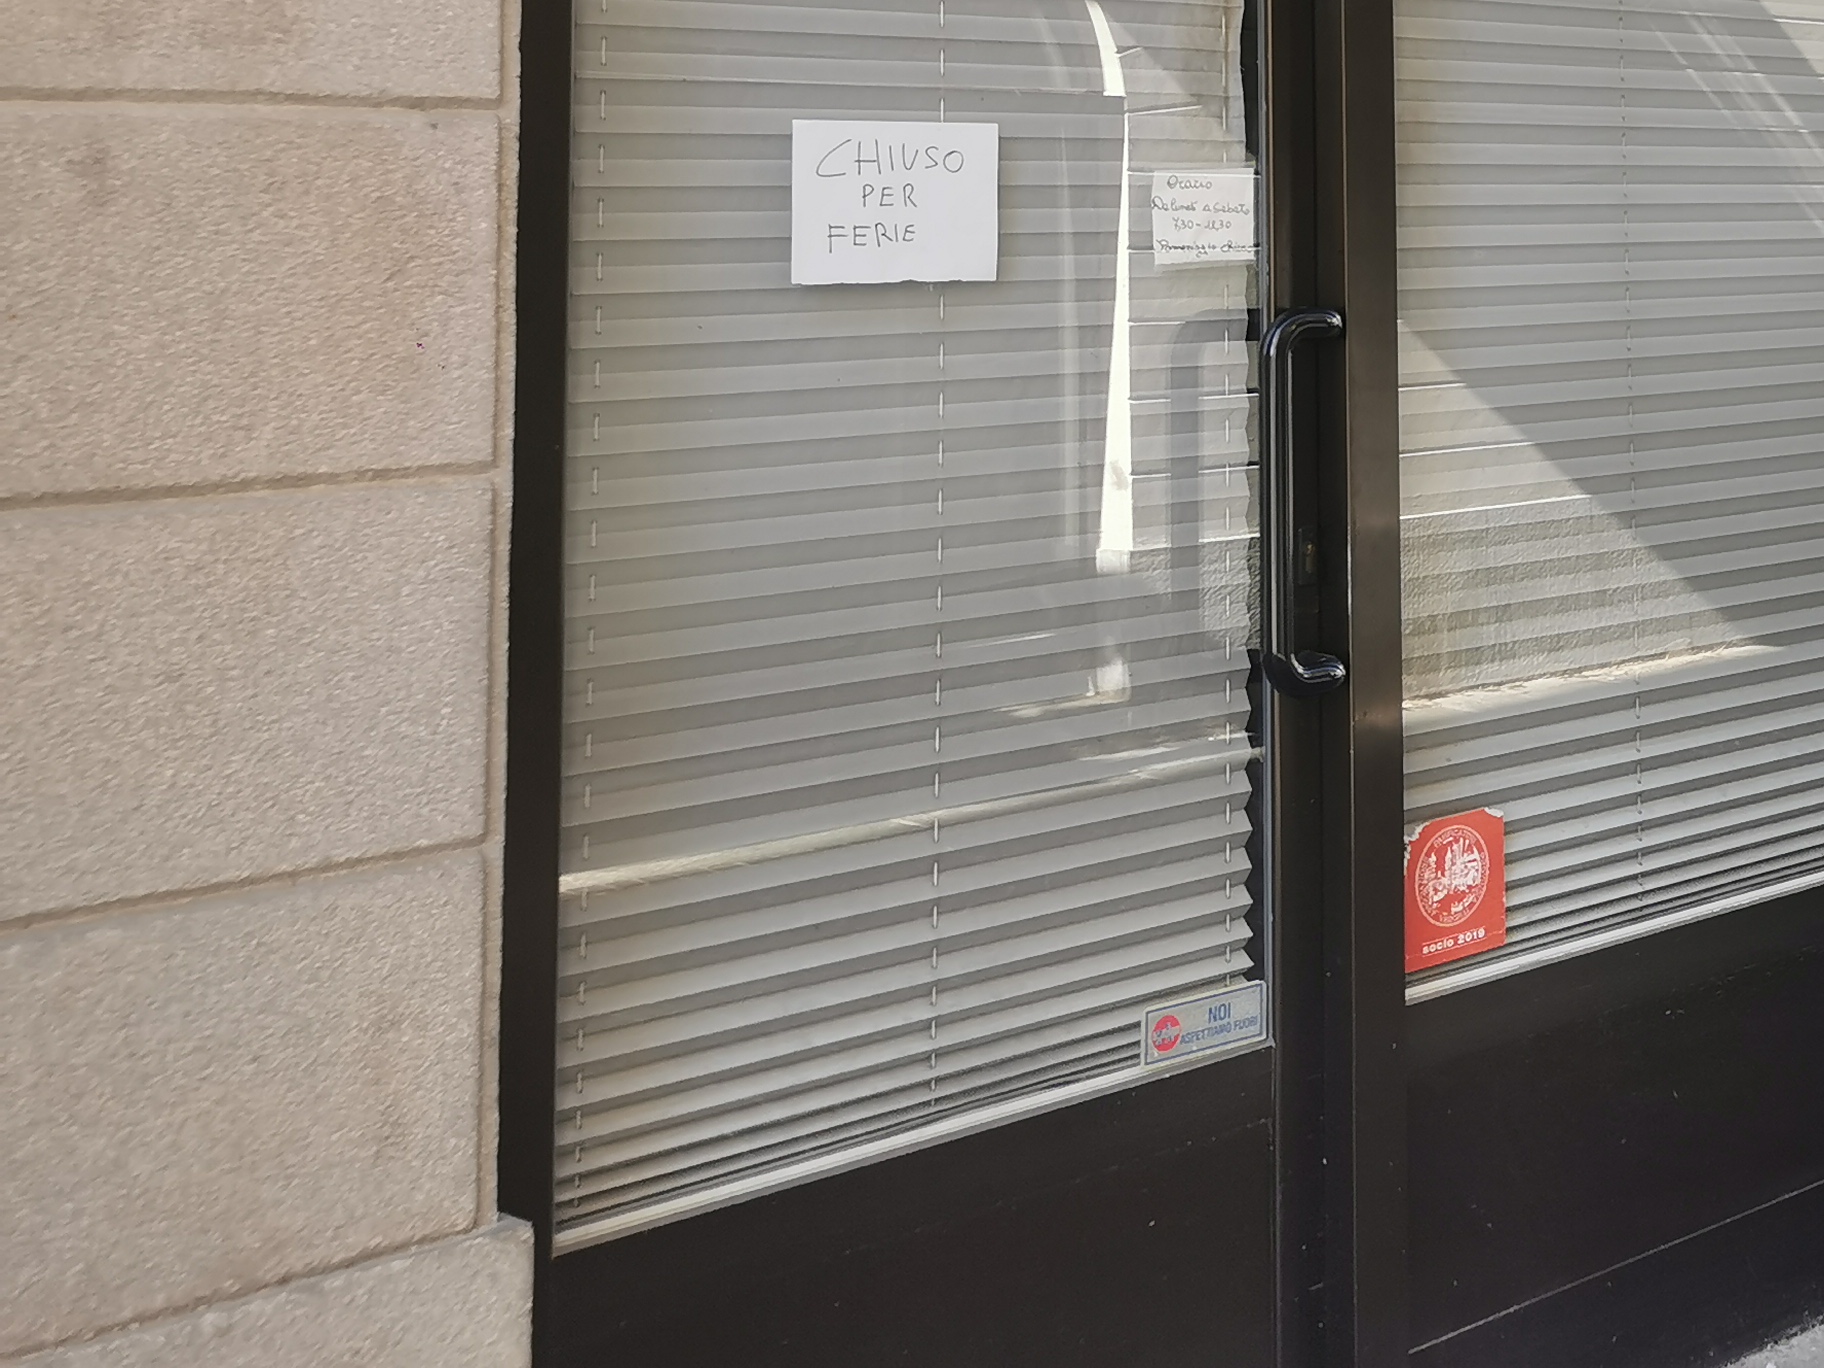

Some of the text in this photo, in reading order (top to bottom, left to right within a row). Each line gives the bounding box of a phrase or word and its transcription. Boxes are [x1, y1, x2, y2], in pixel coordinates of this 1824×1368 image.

[815, 138, 964, 177] CHIUSO
[861, 182, 918, 209] PER
[827, 222, 916, 253] FERIE
[1422, 928, 1486, 954] socio 2019
[1208, 1002, 1231, 1023] NOI
